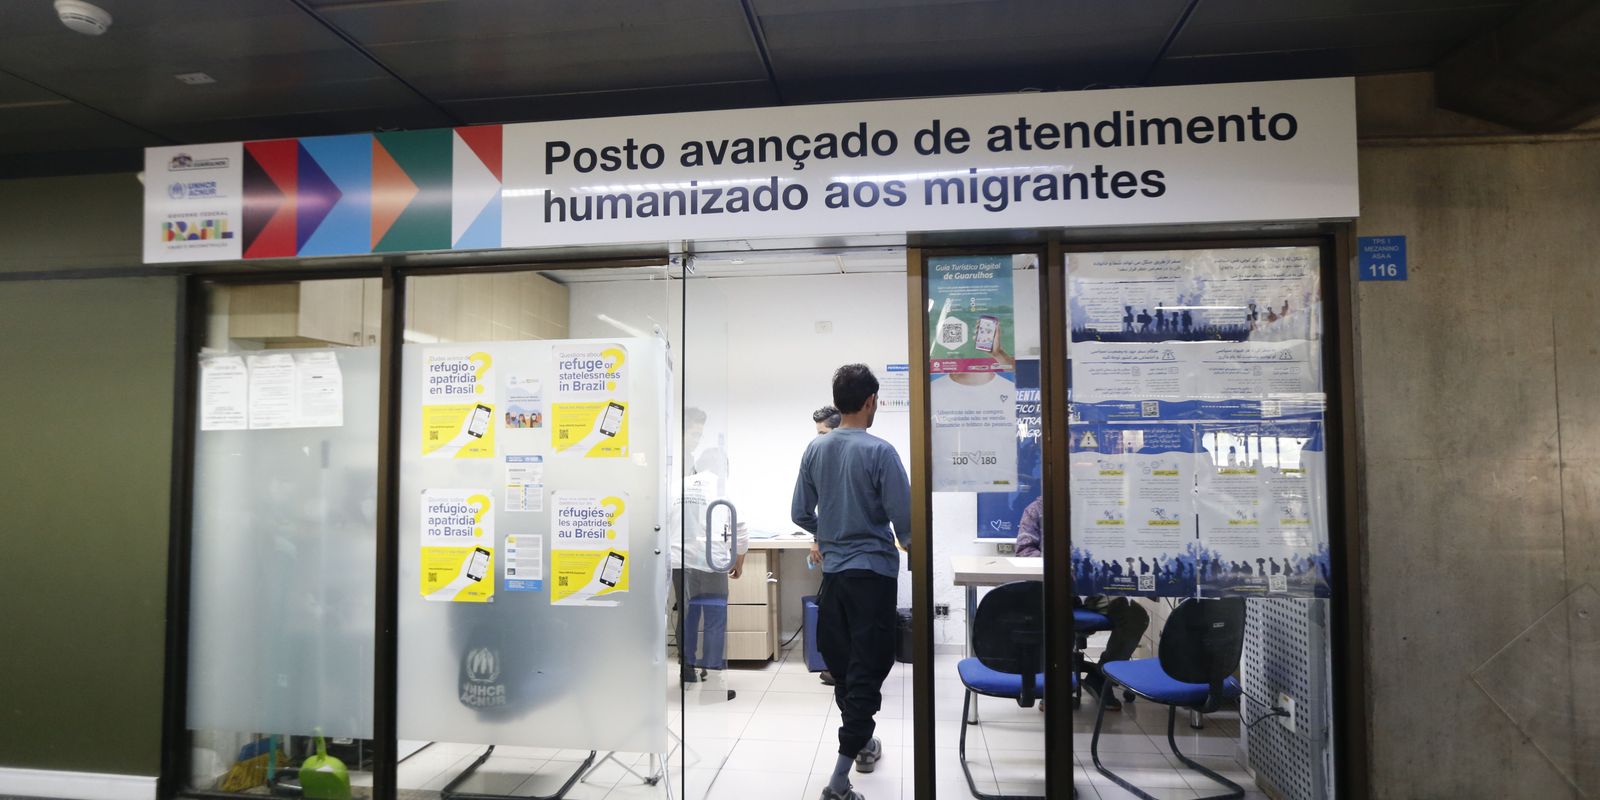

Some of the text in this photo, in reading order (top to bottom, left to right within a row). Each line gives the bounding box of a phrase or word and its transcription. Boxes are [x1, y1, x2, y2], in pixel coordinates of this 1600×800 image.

[545, 104, 1299, 175] Posto avançado de atendimento
[187, 181, 216, 189] UNHCR
[544, 165, 1167, 223] humanizado aos migrantes
[161, 218, 234, 242] BRASIL
[979, 262, 1001, 270] Digital
[1369, 263, 1397, 277] 116
[954, 271, 993, 279] Guarulhos
[430, 361, 469, 374] refugio
[559, 358, 603, 372] refuge
[430, 373, 477, 385] apatridia
[559, 371, 621, 380] statelessness
[445, 385, 474, 394] Brasil
[559, 379, 605, 391] in Brazil
[952, 456, 997, 465] 100 180
[428, 503, 467, 515] refúgio
[558, 507, 604, 519] réfugiés
[572, 518, 612, 528] apatrides
[444, 527, 473, 536] Brasil
[575, 528, 605, 538] Brésil
